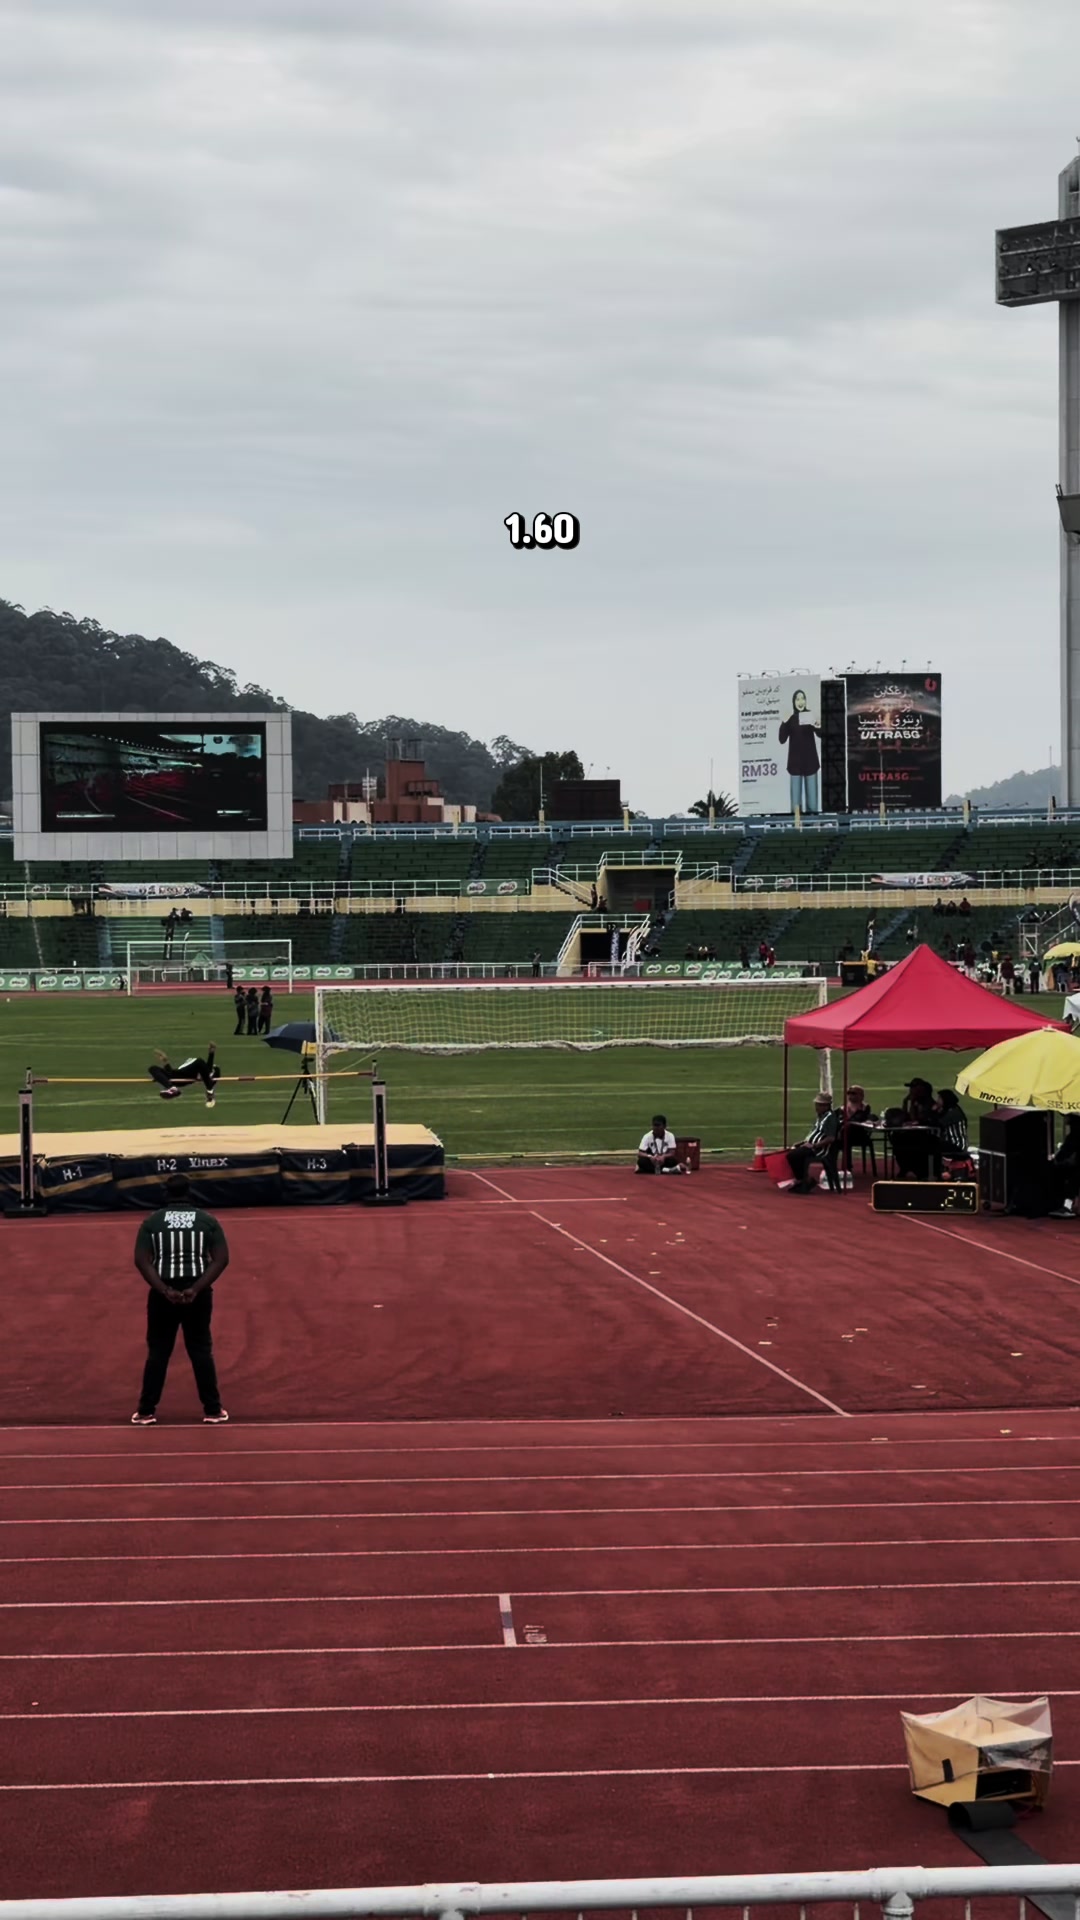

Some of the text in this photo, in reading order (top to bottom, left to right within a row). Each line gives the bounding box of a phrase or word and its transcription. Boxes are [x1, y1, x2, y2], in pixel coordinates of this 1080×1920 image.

[860, 730, 921, 740] ULTRA5G
[742, 763, 778, 777] RM38
[858, 772, 910, 782] ULTRA5G
